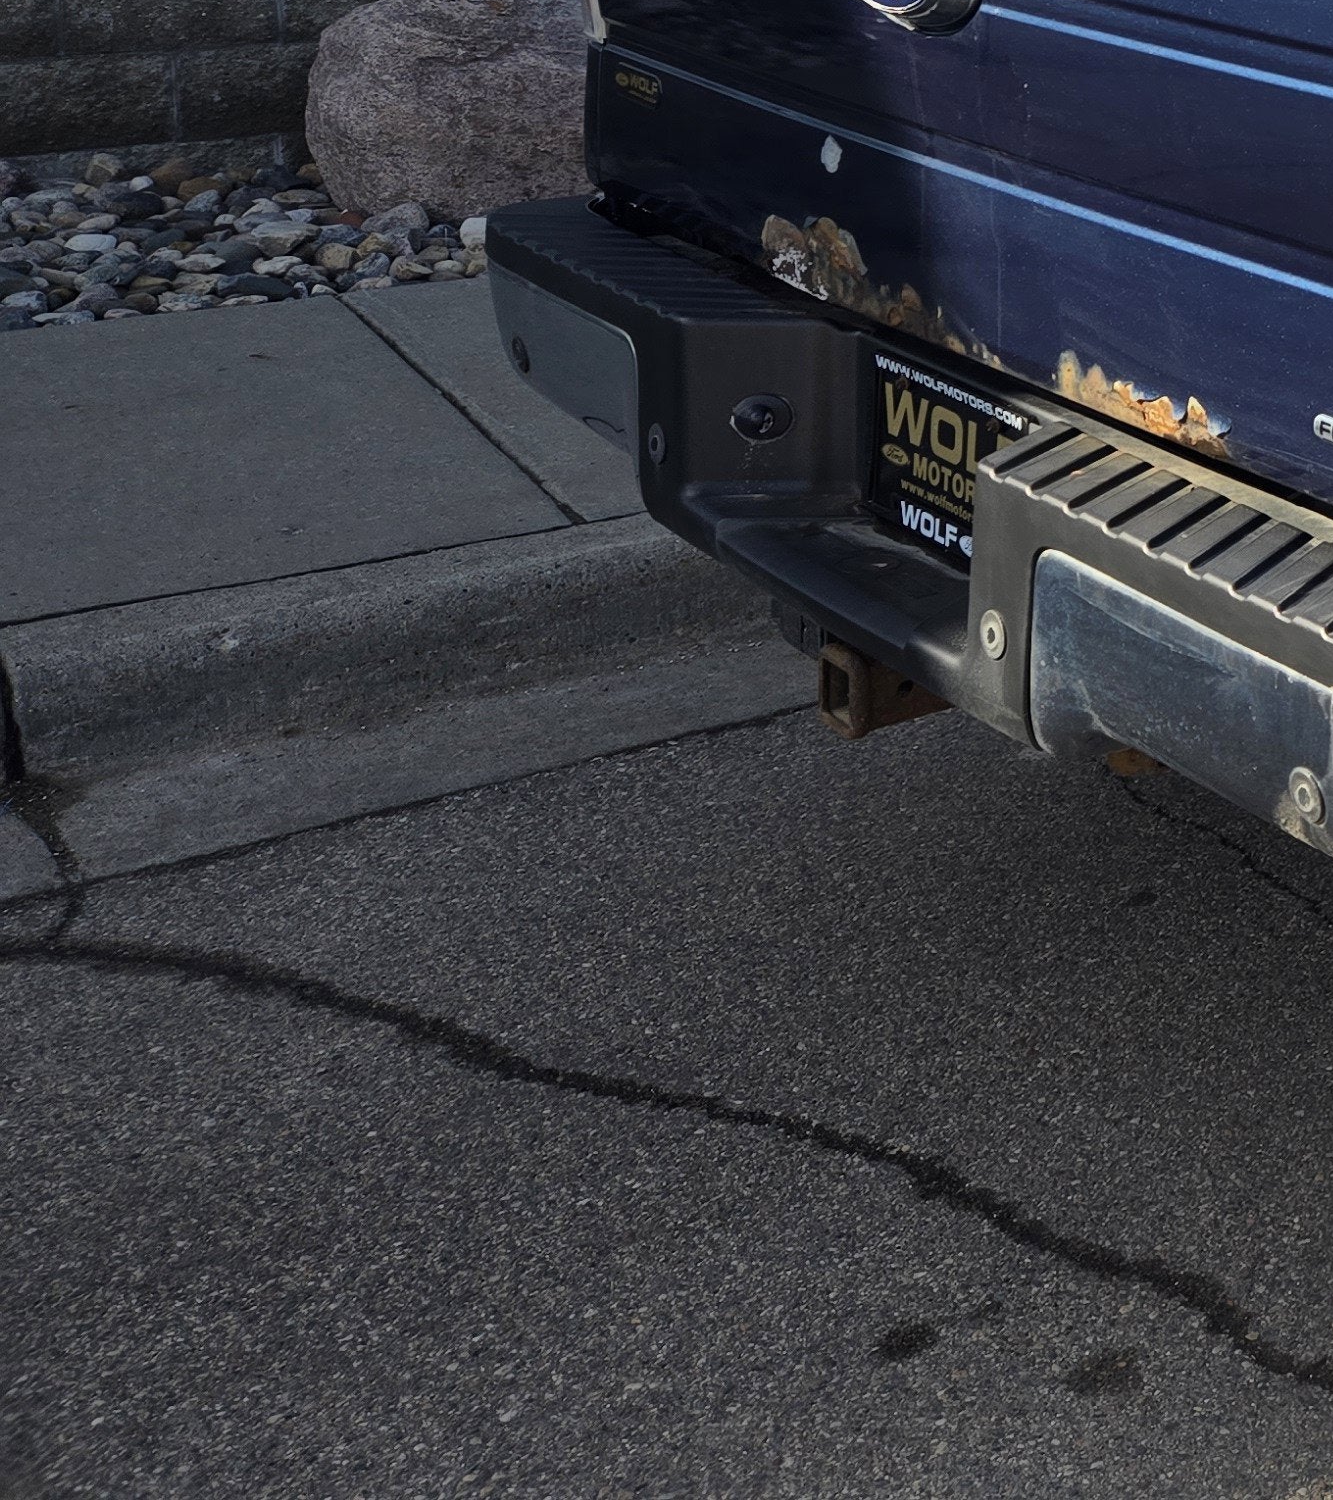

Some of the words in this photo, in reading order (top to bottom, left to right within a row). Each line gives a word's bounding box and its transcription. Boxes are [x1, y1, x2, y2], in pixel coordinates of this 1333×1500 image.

[630, 73, 658, 96] WOLF
[874, 354, 1023, 432] WWW.WOLFMOTORS.COM
[900, 500, 958, 548] WOLF
